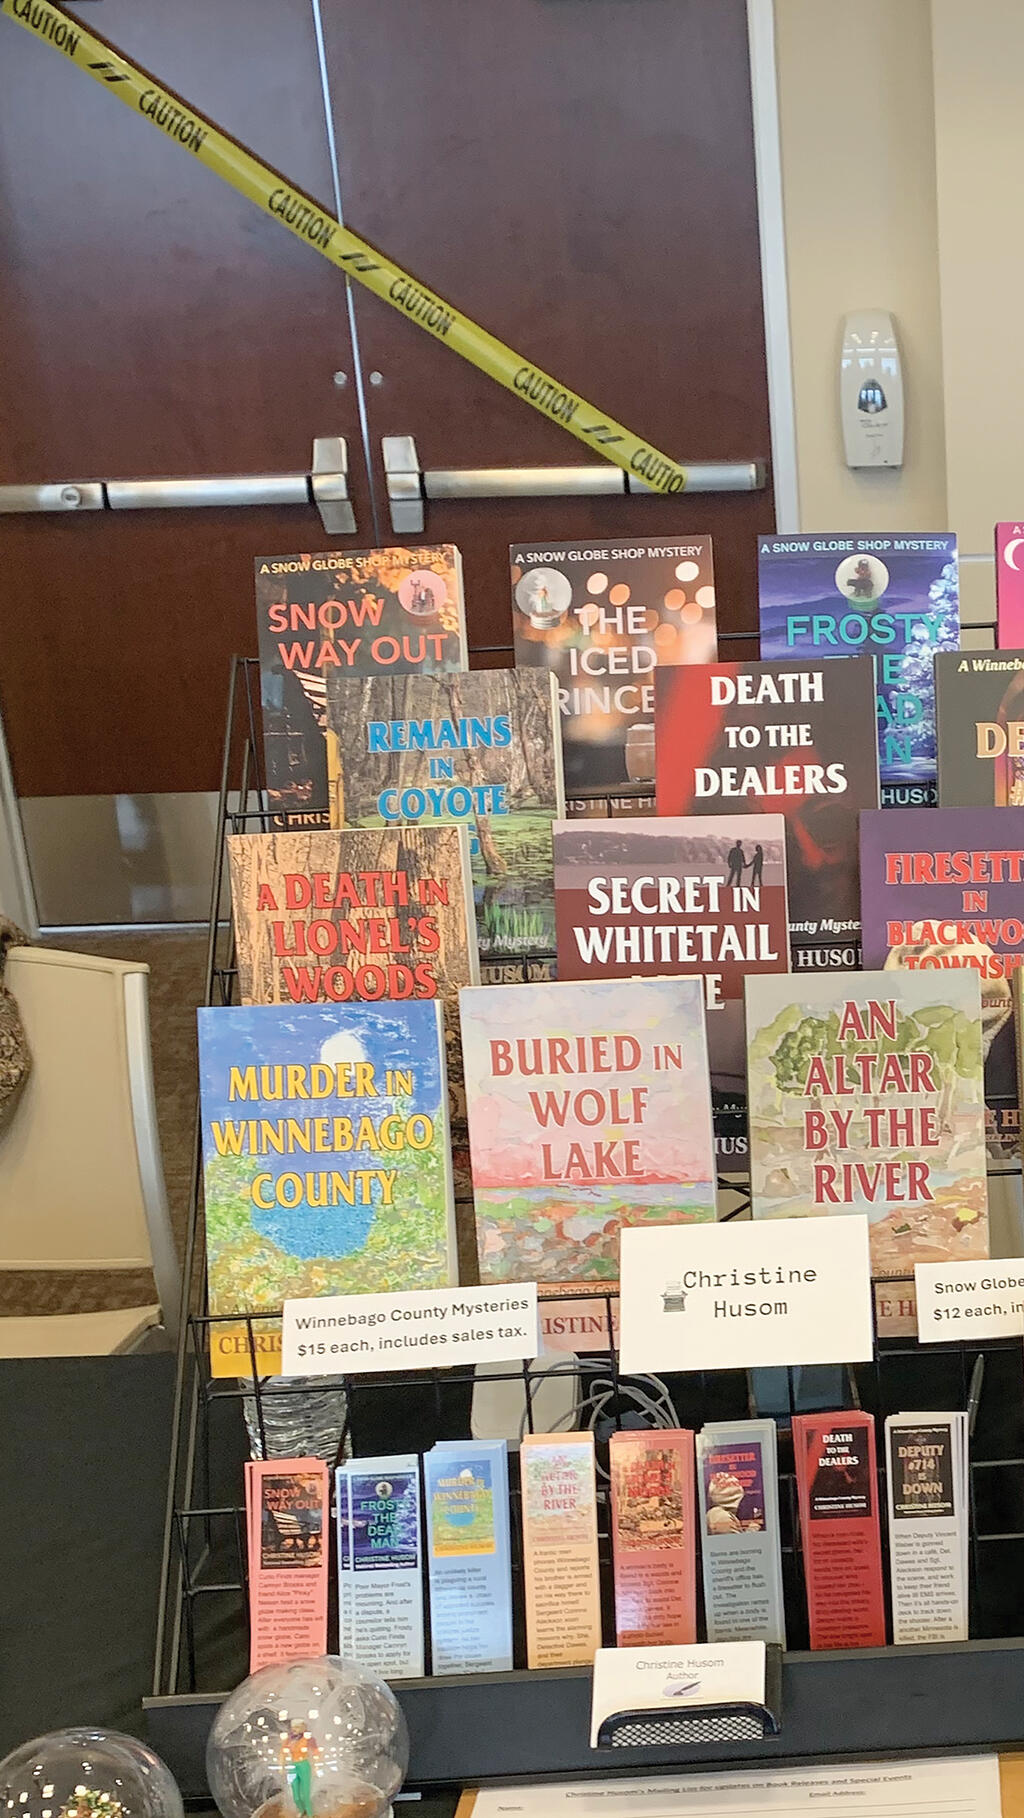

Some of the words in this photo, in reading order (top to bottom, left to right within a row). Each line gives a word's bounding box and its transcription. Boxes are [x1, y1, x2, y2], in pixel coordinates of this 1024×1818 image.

[12, 0, 80, 56] CAUTION
[138, 90, 209, 152] CAUTION
[268, 188, 336, 249] CAUTION
[389, 277, 457, 337] CAUTION
[513, 366, 579, 424] CAUTION
[629, 447, 685, 493] CAUTIO
[761, 544, 770, 554] A
[772, 542, 810, 553] SNOW
[813, 541, 854, 552] GLOBE
[857, 540, 891, 551] SHOP
[894, 539, 949, 550] MYSTERY
[1012, 526, 1022, 535] A
[260, 563, 270, 574] A
[271, 561, 309, 573] SNOW
[312, 557, 352, 571] GLOBE
[355, 555, 392, 568] SHOP
[393, 552, 446, 566] MYSTERY
[515, 553, 525, 564] A
[526, 551, 566, 563] SNOW
[568, 549, 609, 561] GLOBE
[611, 548, 646, 559] SHOP
[648, 545, 703, 558] MYSTERY
[268, 598, 384, 633] SNOW
[574, 606, 648, 636] THE
[786, 612, 945, 647] FROSTY
[279, 638, 361, 670] WAY
[371, 633, 448, 664] OUT
[570, 646, 658, 676] ICED
[958, 661, 968, 672] A
[560, 685, 655, 715] RINCE
[710, 672, 824, 706] DEATH
[367, 717, 512, 753] REMAINS
[724, 725, 760, 749] TO
[764, 724, 813, 747] THE
[429, 757, 454, 780] IN
[695, 763, 848, 798] DEALERS
[377, 784, 509, 821] COYOTE
[257, 884, 278, 910] A
[284, 871, 409, 910] DEATH
[420, 879, 449, 906] IN
[588, 876, 725, 915] SECRET
[732, 886, 761, 913] IN
[962, 891, 988, 912] IN
[273, 917, 440, 957] LIONEL'S
[572, 924, 778, 964] WHITETAIL
[283, 963, 438, 1003] WOODS
[838, 1000, 897, 1041] AN
[490, 1035, 642, 1076] BURIED
[653, 1045, 683, 1071] IN
[229, 1062, 380, 1102] MURDER
[385, 1070, 413, 1097] IN
[803, 1054, 937, 1097] ALTAR
[528, 1087, 648, 1128] WOLF
[210, 1113, 434, 1157] WINNEBAGO
[805, 1109, 853, 1150] BY
[863, 1107, 939, 1148] THE
[541, 1140, 645, 1180] LAKE
[251, 1170, 397, 1210] COUNTY
[814, 1162, 935, 1204] RIVER
[684, 1266, 817, 1289] Christine
[934, 1282, 976, 1294] Snow
[296, 1312, 386, 1330] Winnebago
[390, 1304, 448, 1322] County
[452, 1297, 529, 1317] Mysteries
[714, 1301, 789, 1318] Husom
[933, 1307, 961, 1321] $12
[964, 1302, 1008, 1319] each,
[298, 1342, 326, 1357] $15
[330, 1338, 374, 1354] each,
[379, 1332, 447, 1350] includes
[452, 1327, 494, 1343] sales
[498, 1325, 527, 1339] tax.
[822, 1434, 853, 1444] DEATH
[898, 1445, 945, 1458] DEPUTY
[818, 1456, 859, 1467] DEALERS
[264, 1488, 301, 1500] SNOW
[267, 1500, 294, 1511] WAY
[544, 1498, 577, 1511] RIVER
[556, 1484, 578, 1495] THE
[902, 1483, 943, 1496] DOWN
[374, 1514, 398, 1525] THE
[635, 1660, 684, 1671] Christine
[688, 1659, 724, 1669] Husom
[666, 1672, 699, 1681] Author
